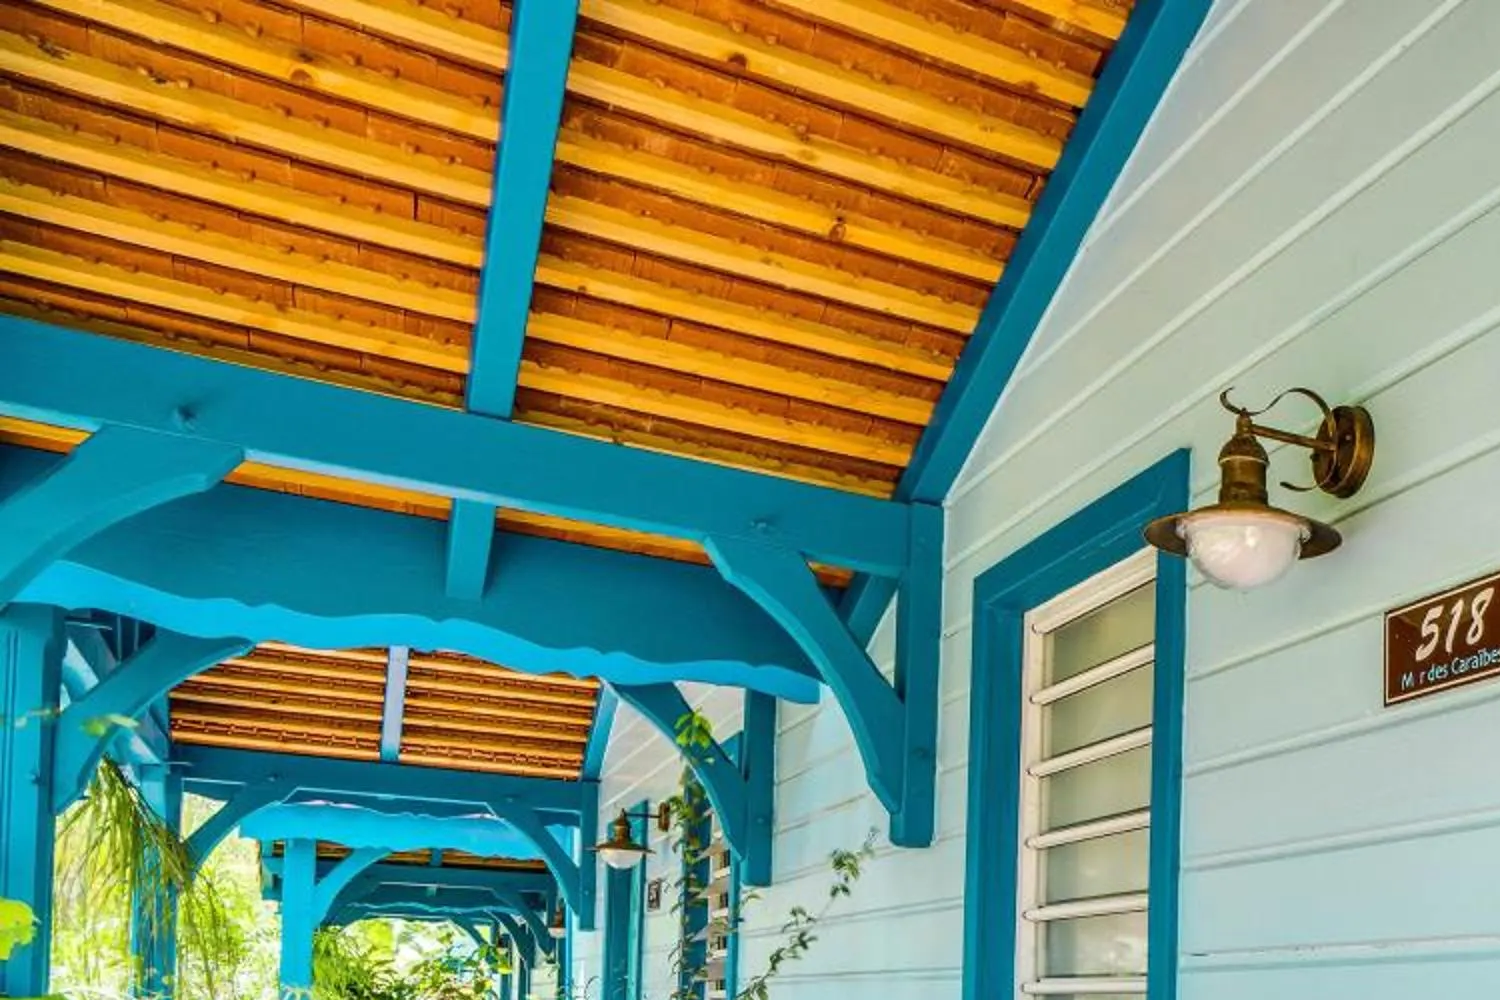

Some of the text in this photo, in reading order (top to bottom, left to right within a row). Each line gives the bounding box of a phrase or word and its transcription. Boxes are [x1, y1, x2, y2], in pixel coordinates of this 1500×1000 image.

[1415, 587, 1495, 662] 518
[1401, 671, 1425, 691] Mr
[1427, 663, 1449, 682] des
